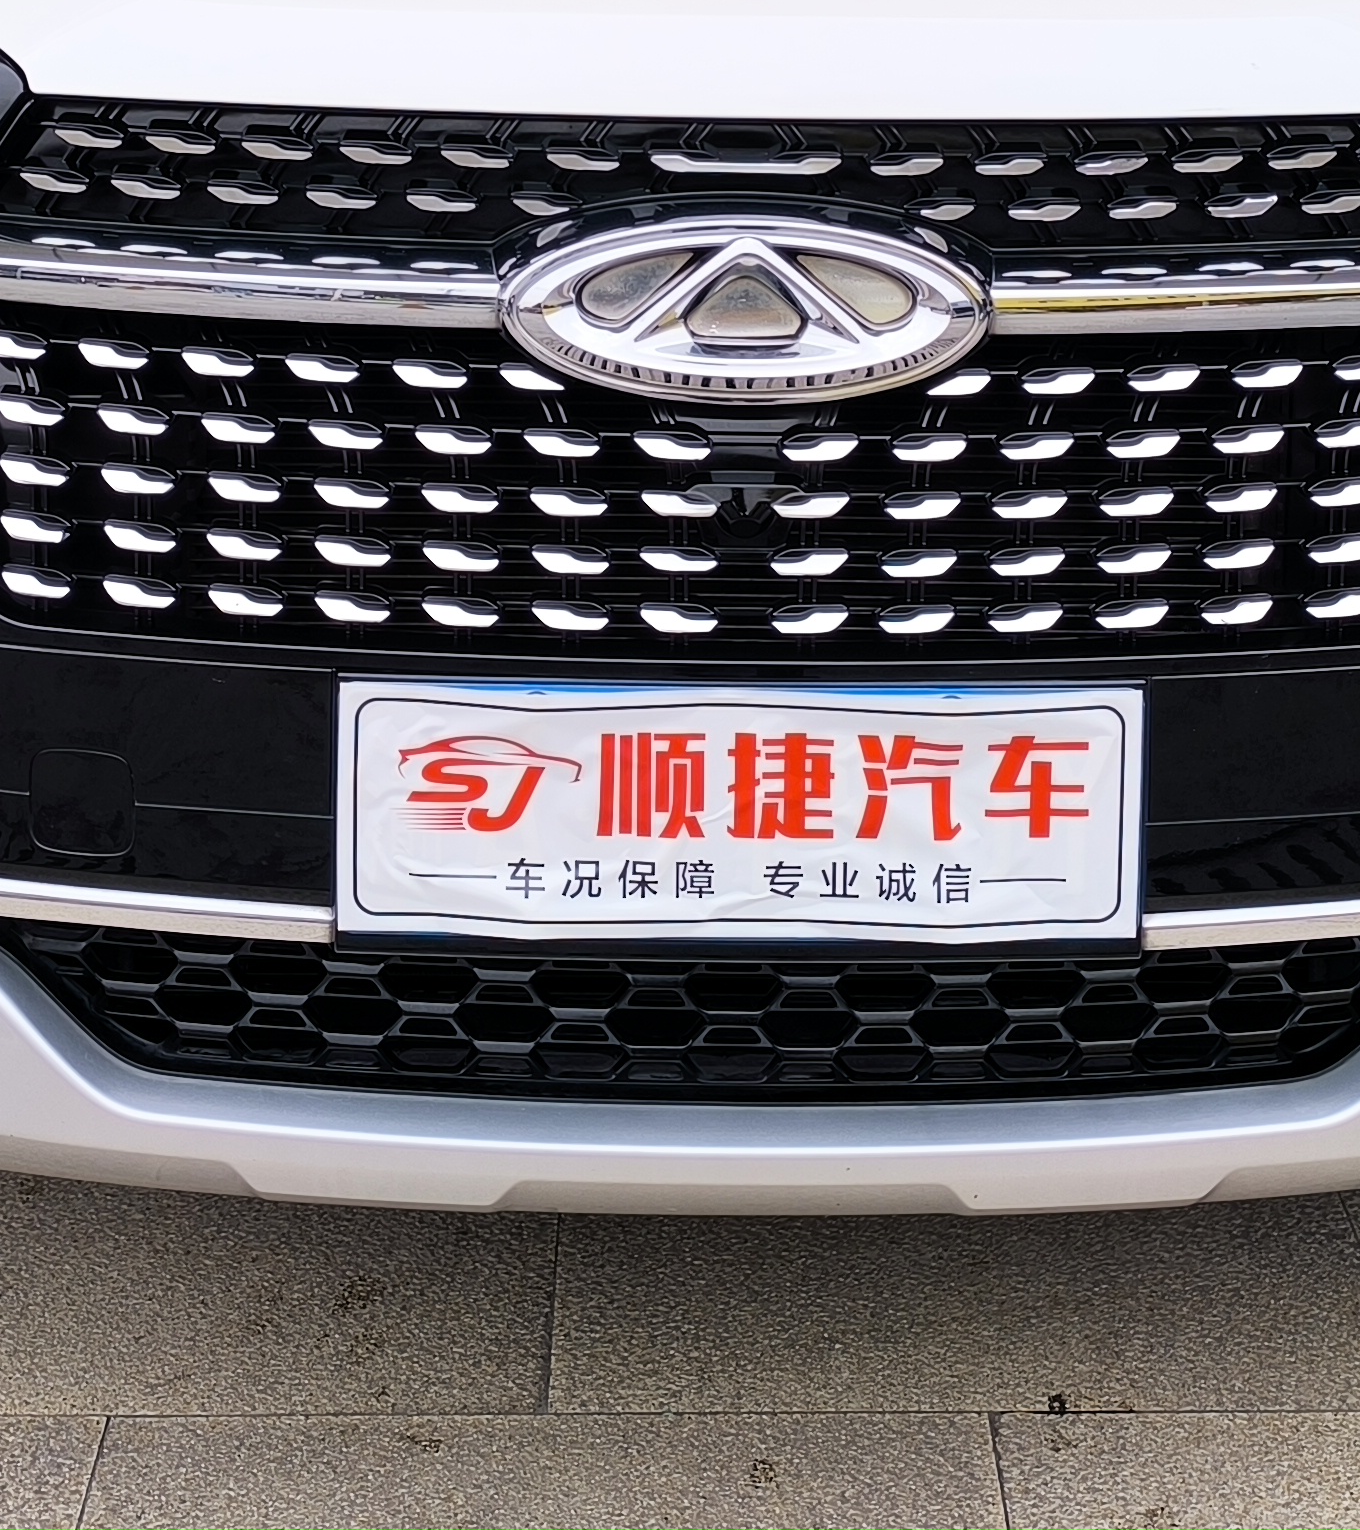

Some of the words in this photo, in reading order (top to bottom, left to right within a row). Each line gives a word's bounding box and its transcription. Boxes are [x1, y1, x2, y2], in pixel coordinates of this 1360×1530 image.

[597, 732, 1090, 841] 顺捷汽车
[504, 859, 717, 901] 车况保障
[762, 861, 974, 905] 专业诚信
